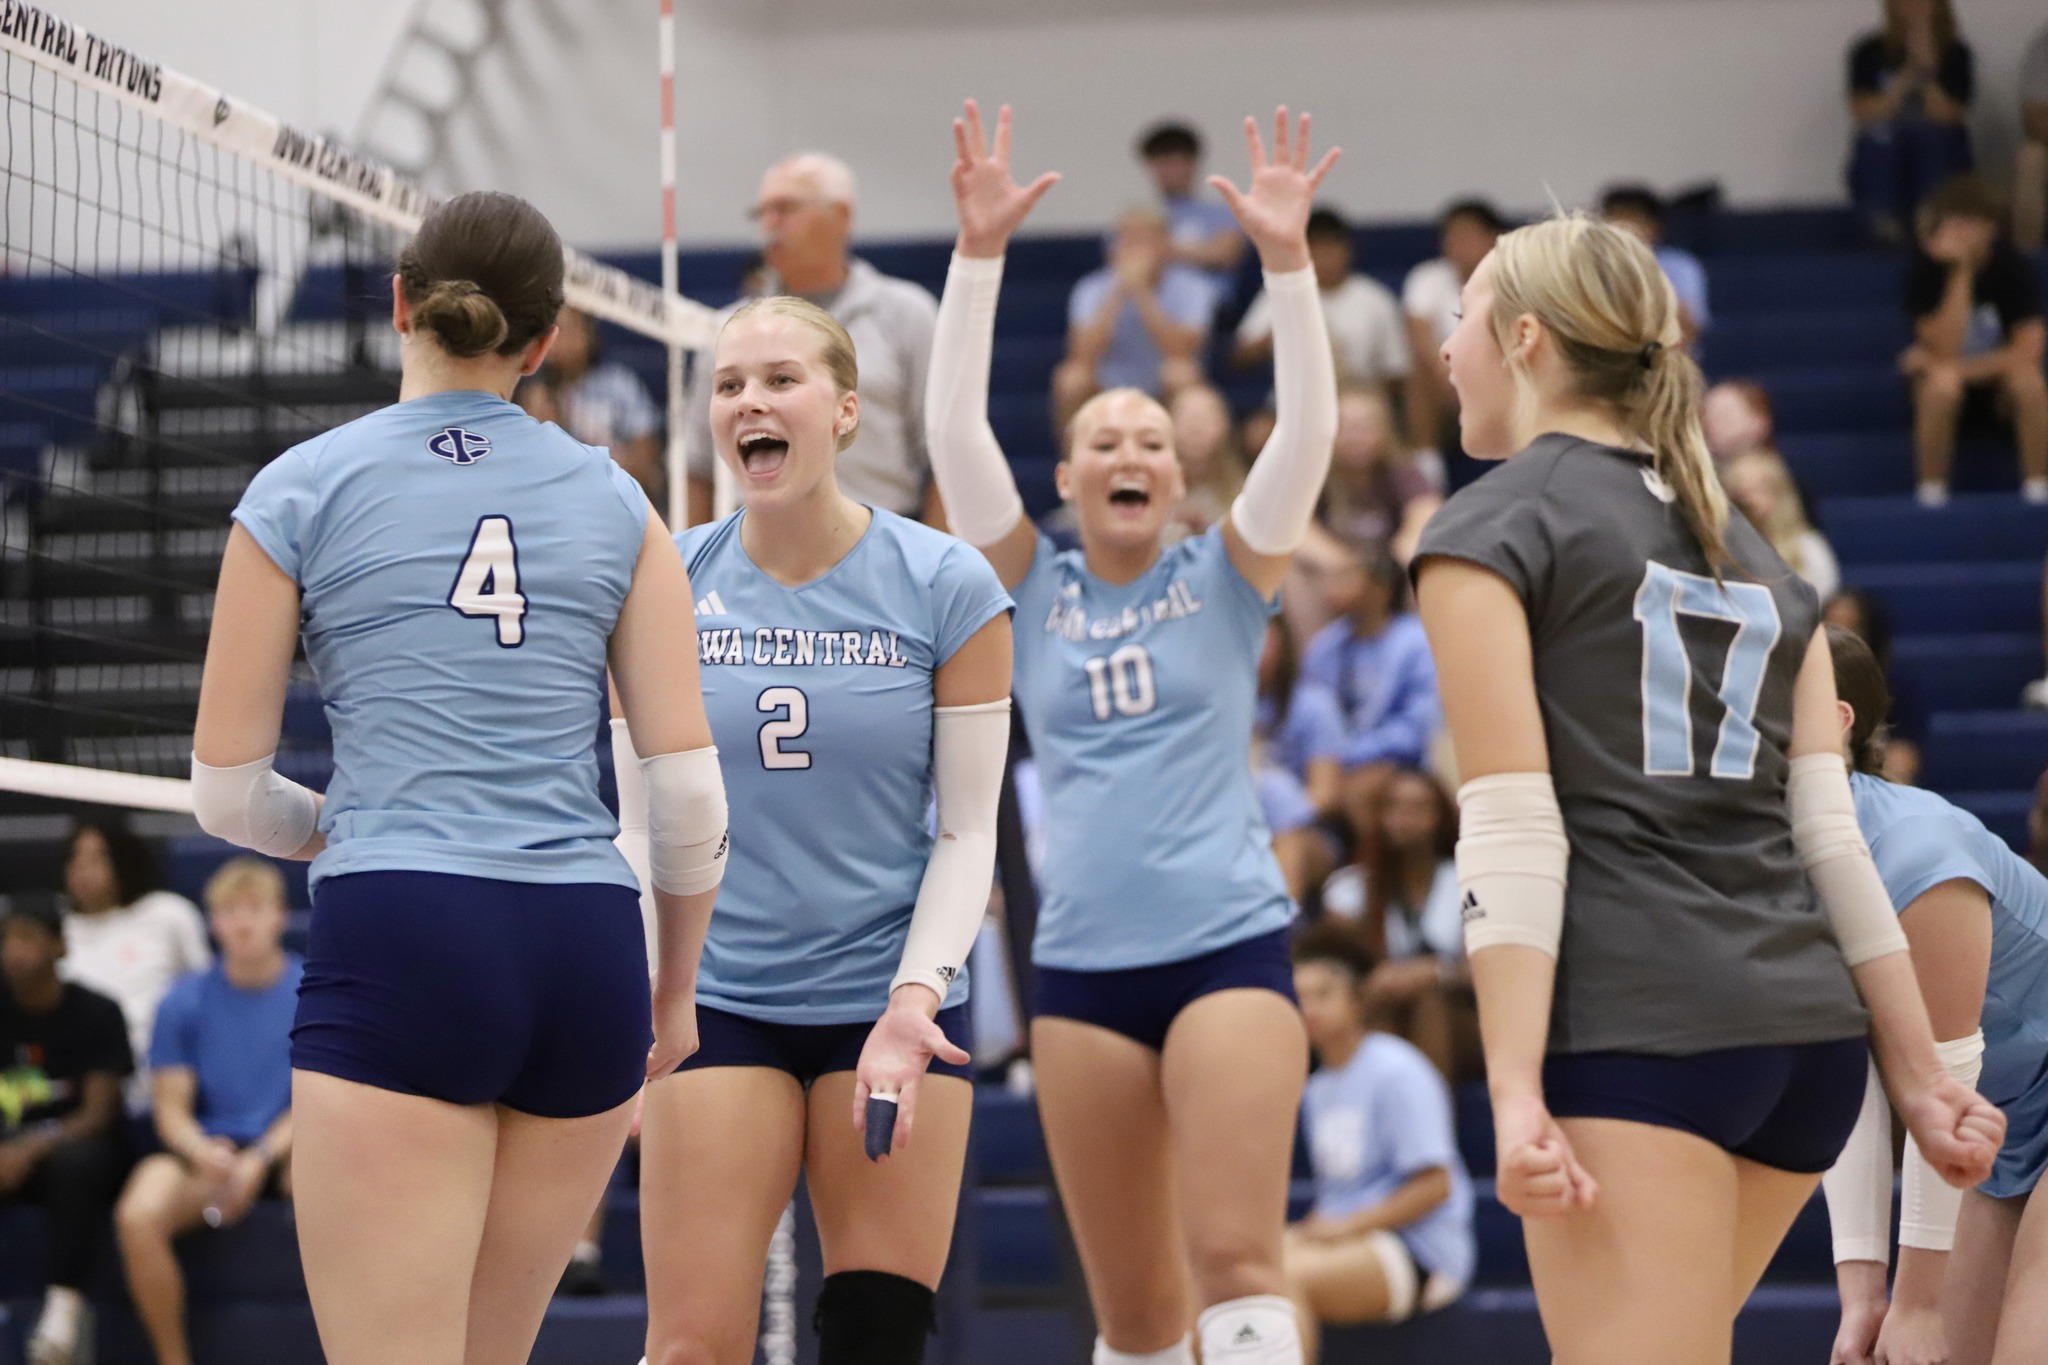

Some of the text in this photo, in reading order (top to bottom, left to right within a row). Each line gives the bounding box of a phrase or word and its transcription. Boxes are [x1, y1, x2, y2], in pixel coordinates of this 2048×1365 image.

[0, 0, 163, 103] ENTRAL TRITONS
[447, 513, 529, 649] 4
[697, 626, 909, 669] WA CENTRAL
[1084, 644, 1156, 721] 10
[1633, 559, 1783, 780] 17
[756, 686, 813, 771] 2
